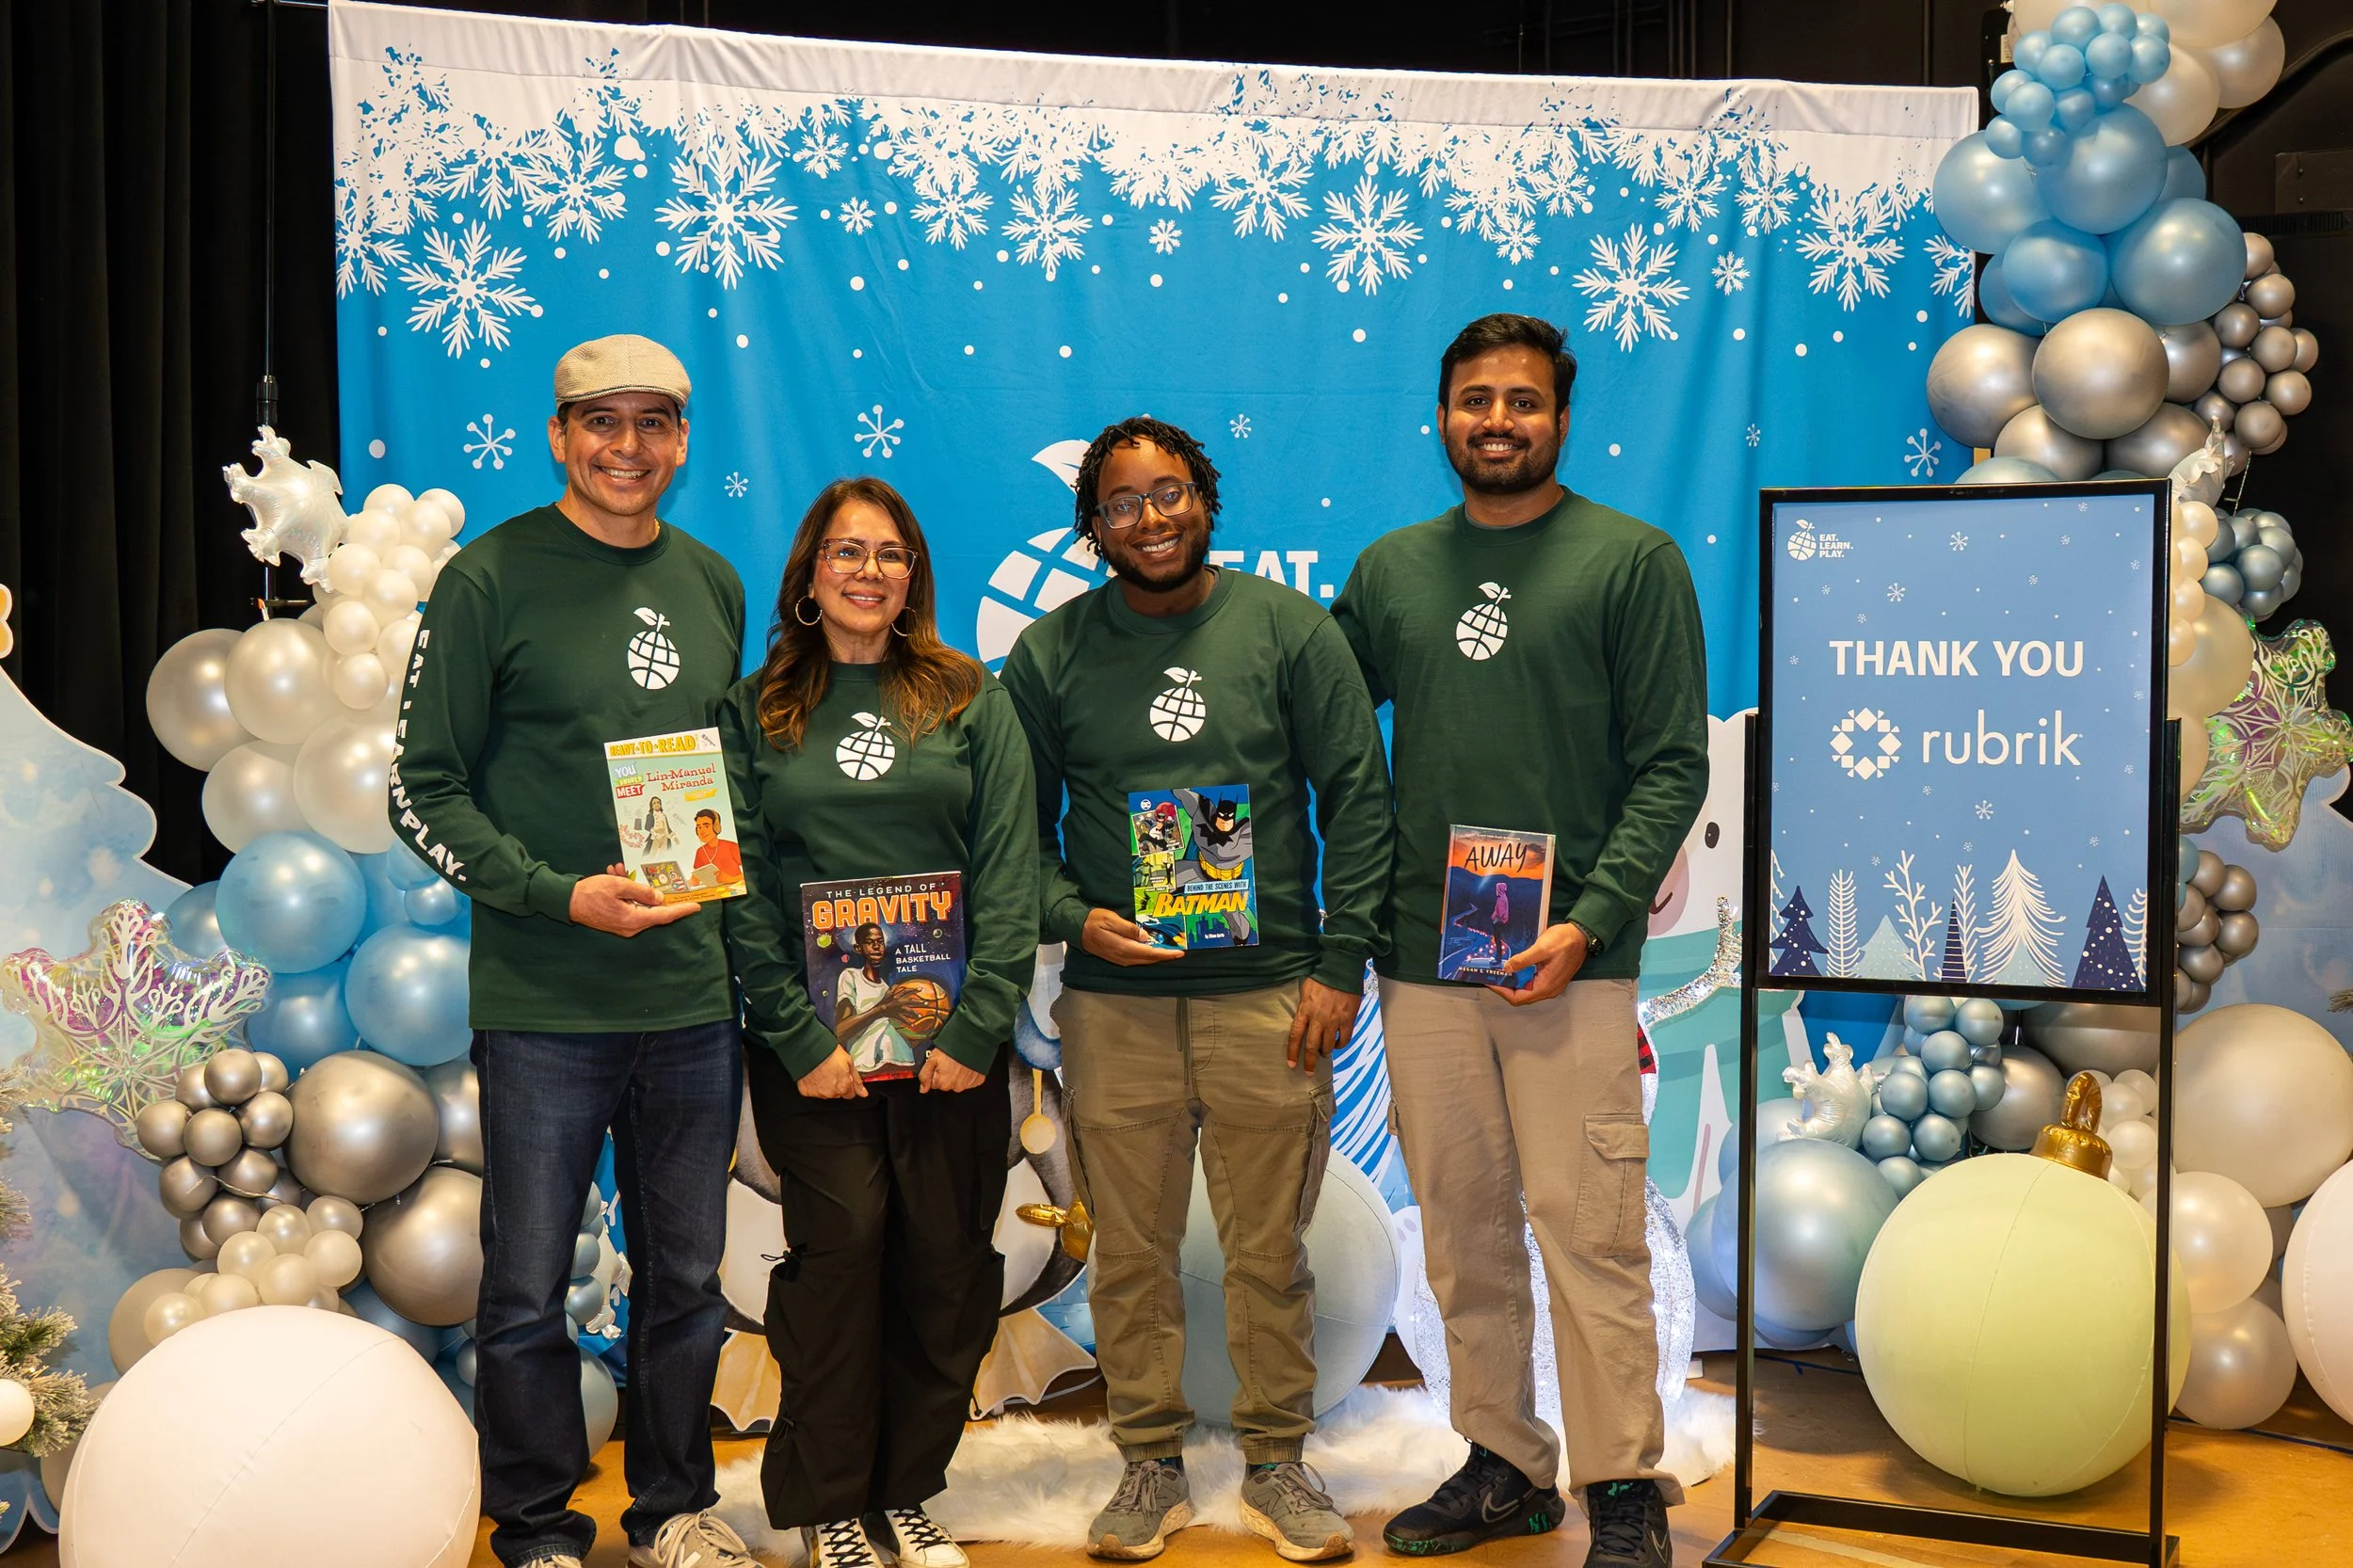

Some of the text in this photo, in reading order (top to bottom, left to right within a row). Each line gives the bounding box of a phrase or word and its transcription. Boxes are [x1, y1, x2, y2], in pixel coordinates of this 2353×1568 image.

[1818, 541, 1854, 550] LEARN.
[1818, 550, 1845, 558] PLAY.
[1829, 639, 2085, 678] THANK YOU
[1922, 709, 2082, 766] rubrik
[615, 764, 637, 777] YOU
[647, 763, 716, 782] Lin-Manuel
[618, 776, 643, 785] SHOULD
[662, 776, 714, 792] Miranda
[616, 785, 642, 798] MEET
[400, 808, 467, 882] PLAY.
[1464, 842, 1529, 872] AWAY
[826, 883, 936, 899] THE LEGEND OF
[1187, 883, 1204, 892] BEHIND
[1215, 882, 1233, 890] SCENES
[811, 890, 953, 931] GRAVITY
[1152, 891, 1250, 918] BATMAN
[904, 943, 927, 955] TALL
[896, 953, 952, 965] BASKETBALL
[896, 965, 918, 973] TALE
